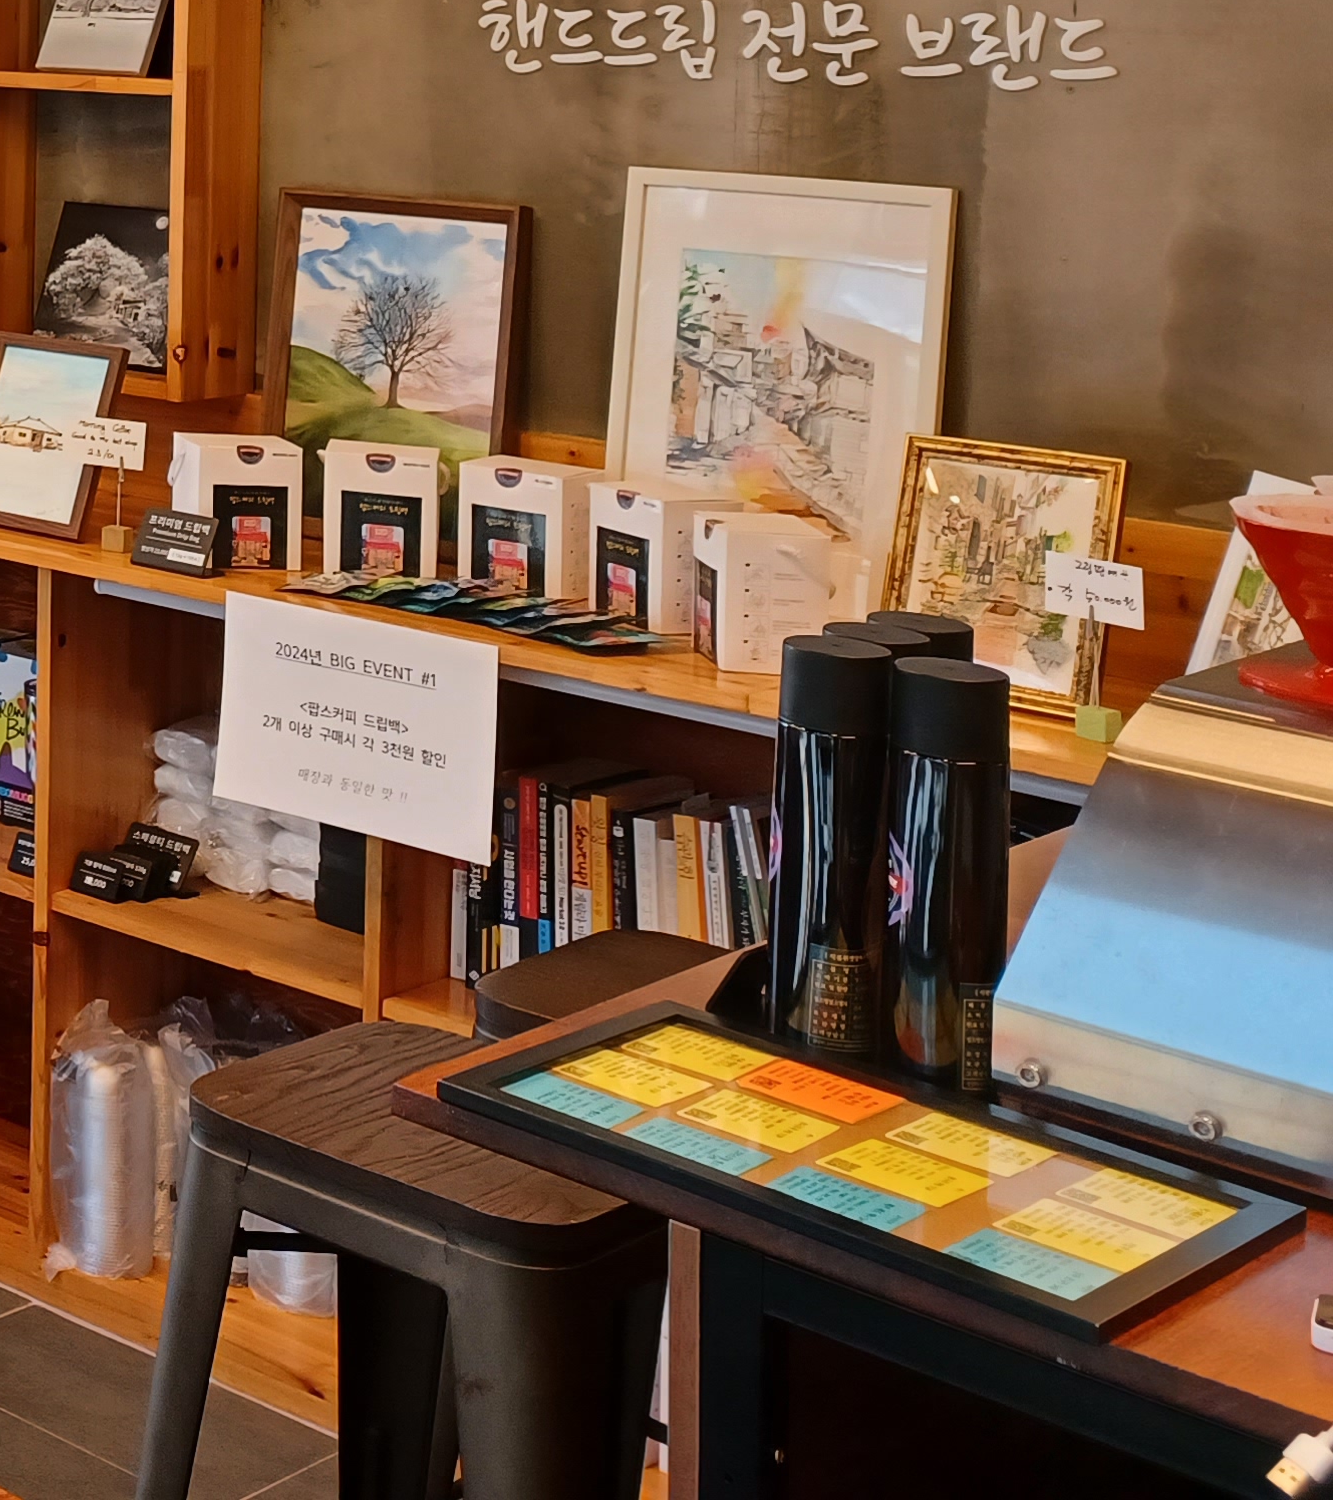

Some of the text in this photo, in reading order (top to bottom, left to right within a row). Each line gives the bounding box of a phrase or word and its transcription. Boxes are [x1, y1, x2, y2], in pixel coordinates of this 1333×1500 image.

[741, 1, 879, 86] 전문
[899, 4, 1118, 92] 브랜드
[275, 642, 437, 687] 2024년 BIG EVENT #1
[262, 714, 447, 769] 2개 이상 구매시 각 3천원 할인
[363, 715, 409, 735] 드립백>
